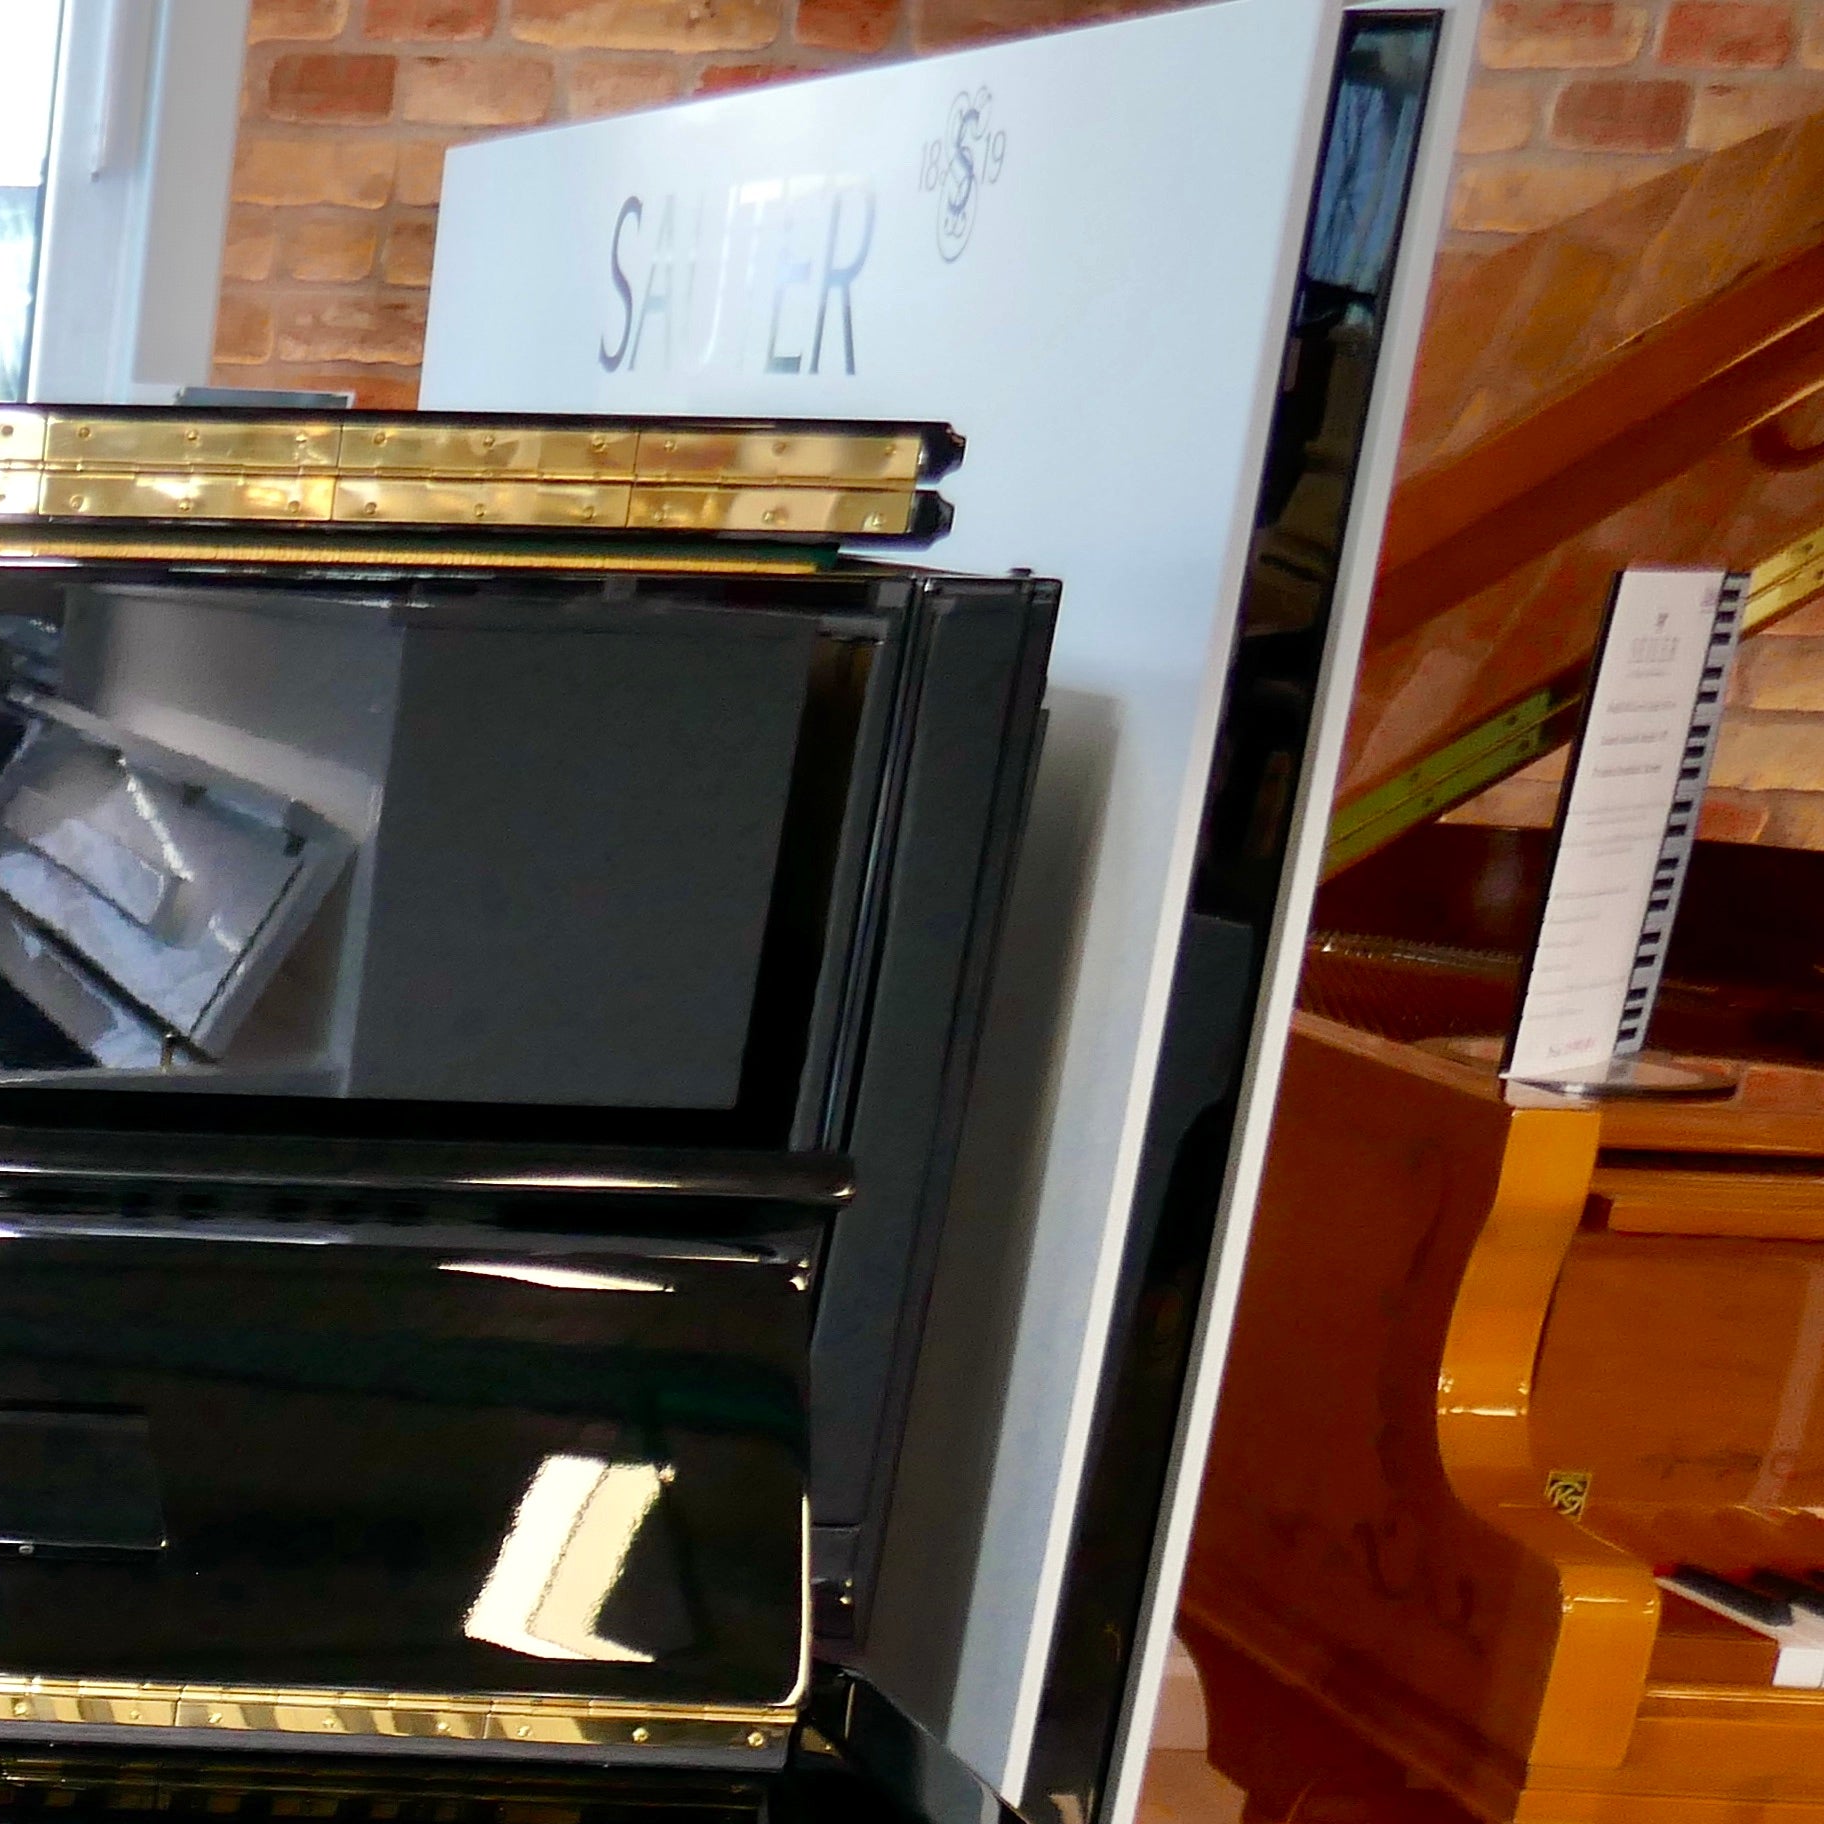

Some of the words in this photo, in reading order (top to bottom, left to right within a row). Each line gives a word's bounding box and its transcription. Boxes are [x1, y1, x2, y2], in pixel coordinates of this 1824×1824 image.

[918, 137, 942, 192] 18
[980, 129, 1007, 185] 19
[598, 182, 877, 375] SAUTER
